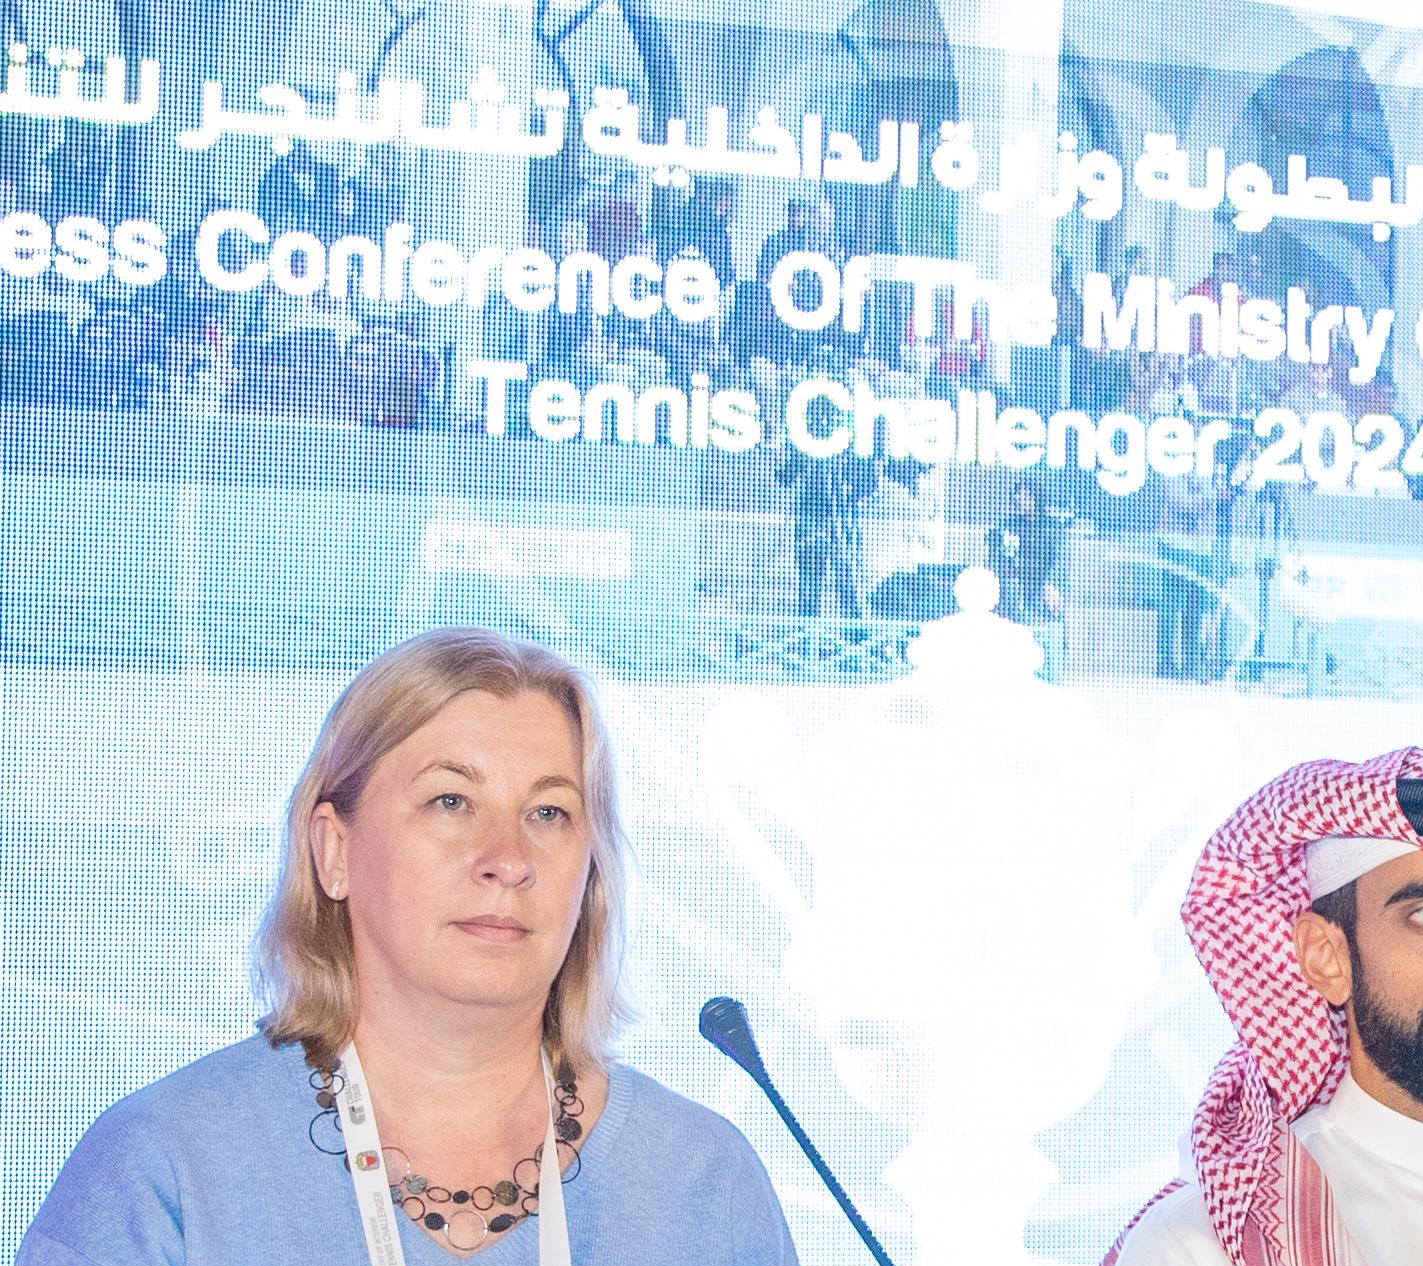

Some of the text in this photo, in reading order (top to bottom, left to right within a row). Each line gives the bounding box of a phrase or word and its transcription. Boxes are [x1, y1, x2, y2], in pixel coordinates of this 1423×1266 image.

[179, 63, 569, 157] تشالنجر
[585, 84, 919, 188] الداخلية
[931, 120, 1123, 222] وزارة
[199, 208, 722, 324] Conference
[771, 247, 871, 333] Of
[894, 253, 1058, 347] The
[1083, 271, 1395, 385] Ministry
[467, 358, 764, 453] Tennis
[785, 375, 1231, 497] Challenger
